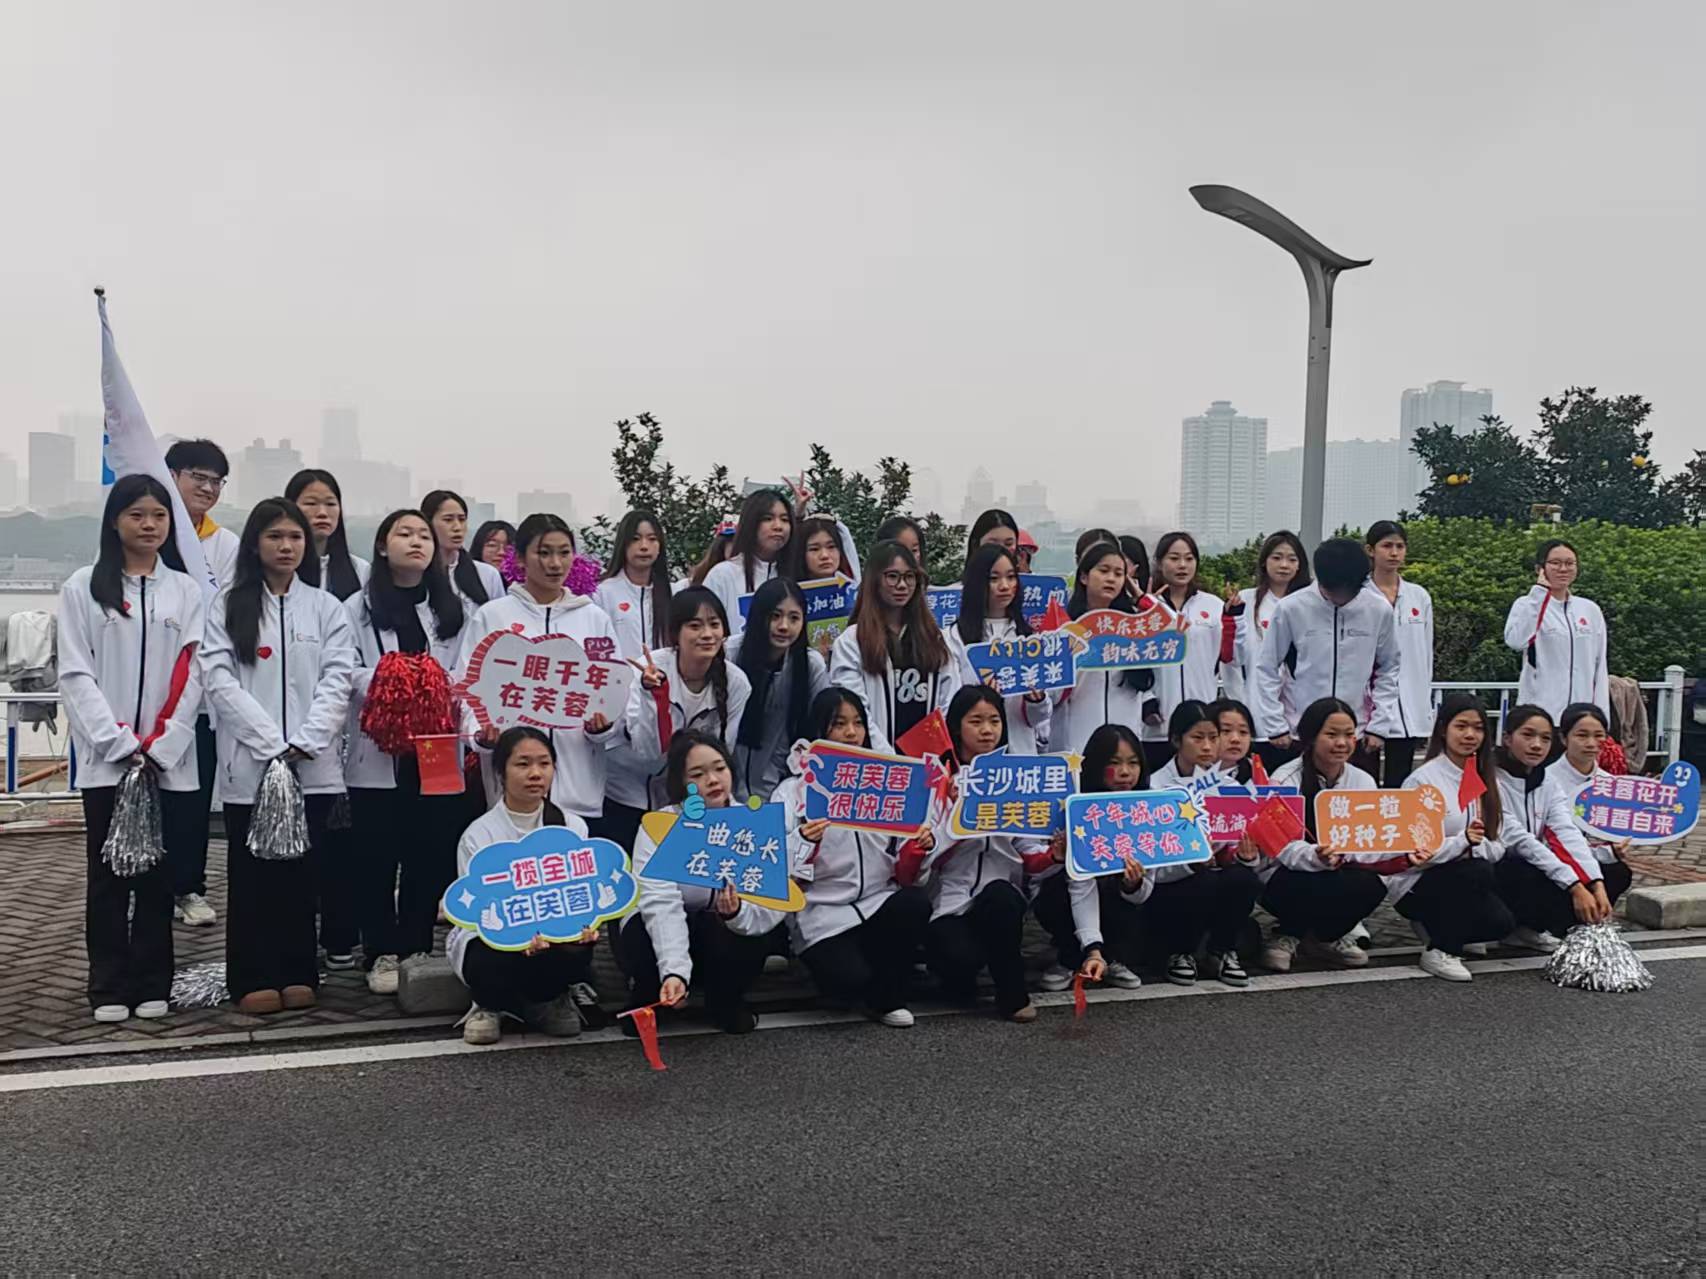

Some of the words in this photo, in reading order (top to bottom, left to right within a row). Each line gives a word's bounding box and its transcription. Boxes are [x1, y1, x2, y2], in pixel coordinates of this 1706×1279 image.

[806, 593, 845, 614] 加油
[1096, 613, 1164, 635] 快乐芙蓉
[1102, 638, 1179, 663] 韵味无穷
[996, 661, 1063, 689] 来芙蓉
[499, 682, 590, 718] 在芙蓉
[833, 762, 912, 791] 来芙蓉
[958, 765, 1068, 796] 长沙城里
[1592, 775, 1678, 805] 芙蓉花开
[828, 792, 905, 820] 很快乐
[975, 801, 1051, 830] 是芙蓉
[1083, 800, 1175, 829] 千年城心
[1328, 795, 1401, 819] 做一粒
[1589, 805, 1674, 835] 清香自来
[1211, 813, 1258, 833] 流淌
[1329, 823, 1401, 848] 好种子
[683, 822, 779, 864] 一曲悠长
[1090, 832, 1184, 860] 芙蓉等你
[483, 849, 597, 888] 一揽全城
[686, 850, 763, 892] 在芙蓉
[504, 884, 592, 925] 在芙蓉
